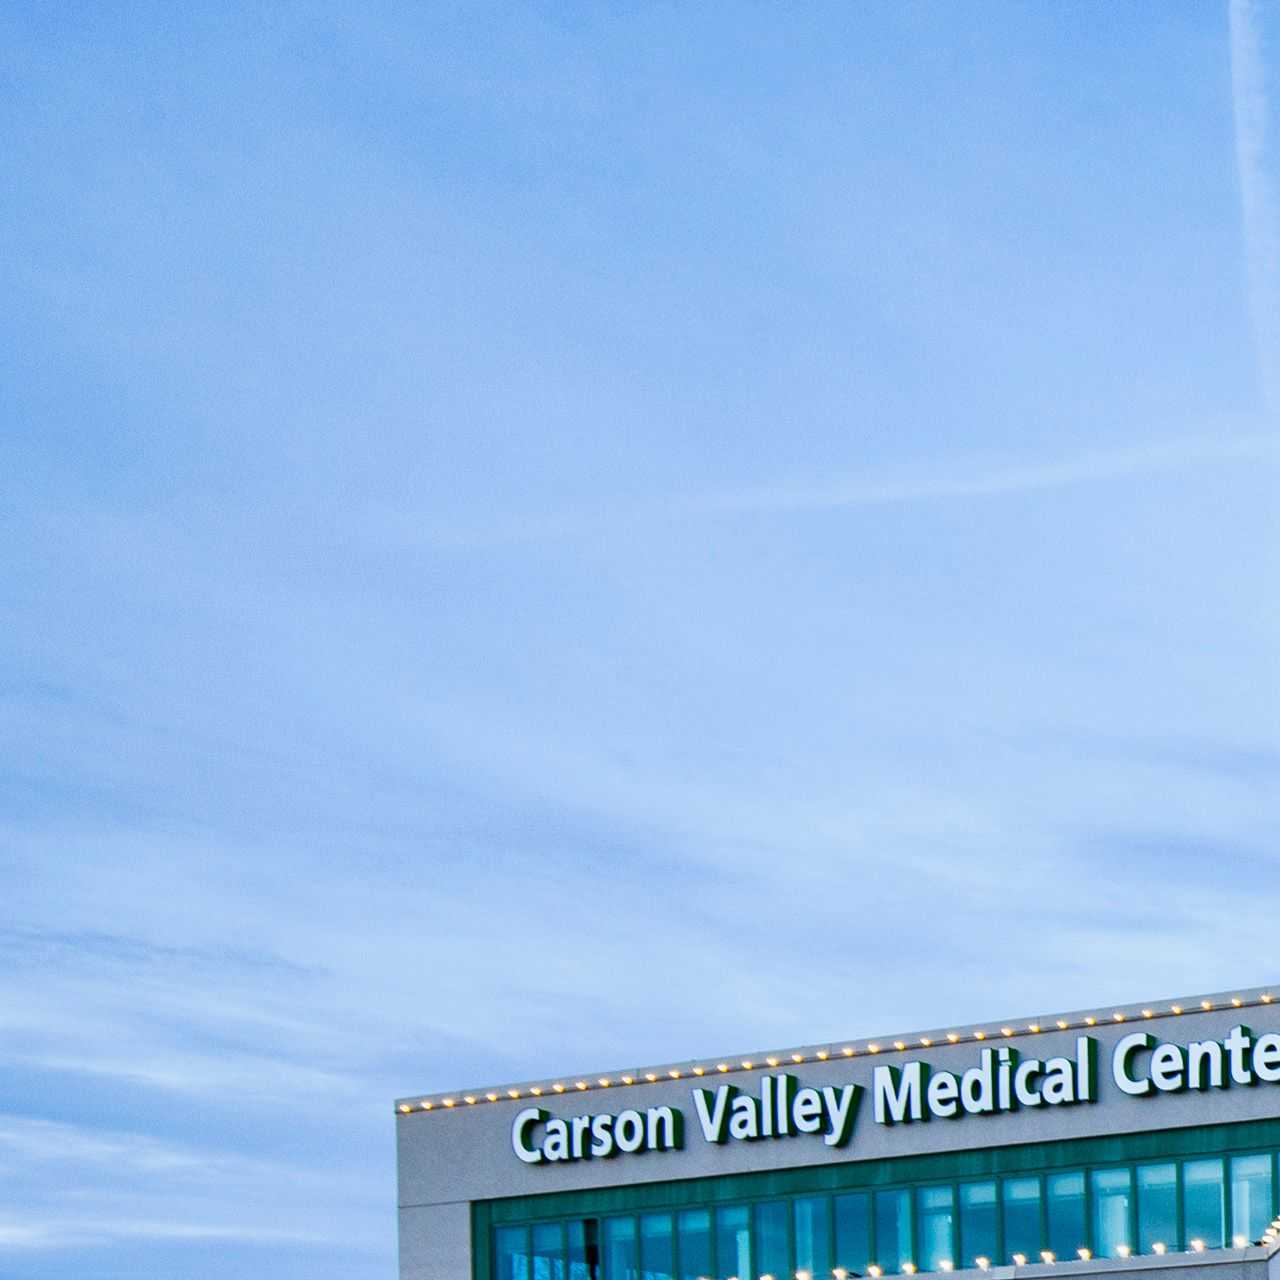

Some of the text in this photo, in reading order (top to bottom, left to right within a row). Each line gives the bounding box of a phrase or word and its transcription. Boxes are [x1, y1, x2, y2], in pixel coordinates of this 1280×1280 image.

[513, 1105, 680, 1164] Carson
[693, 1075, 860, 1147] Valley
[874, 1037, 1096, 1125] Medical
